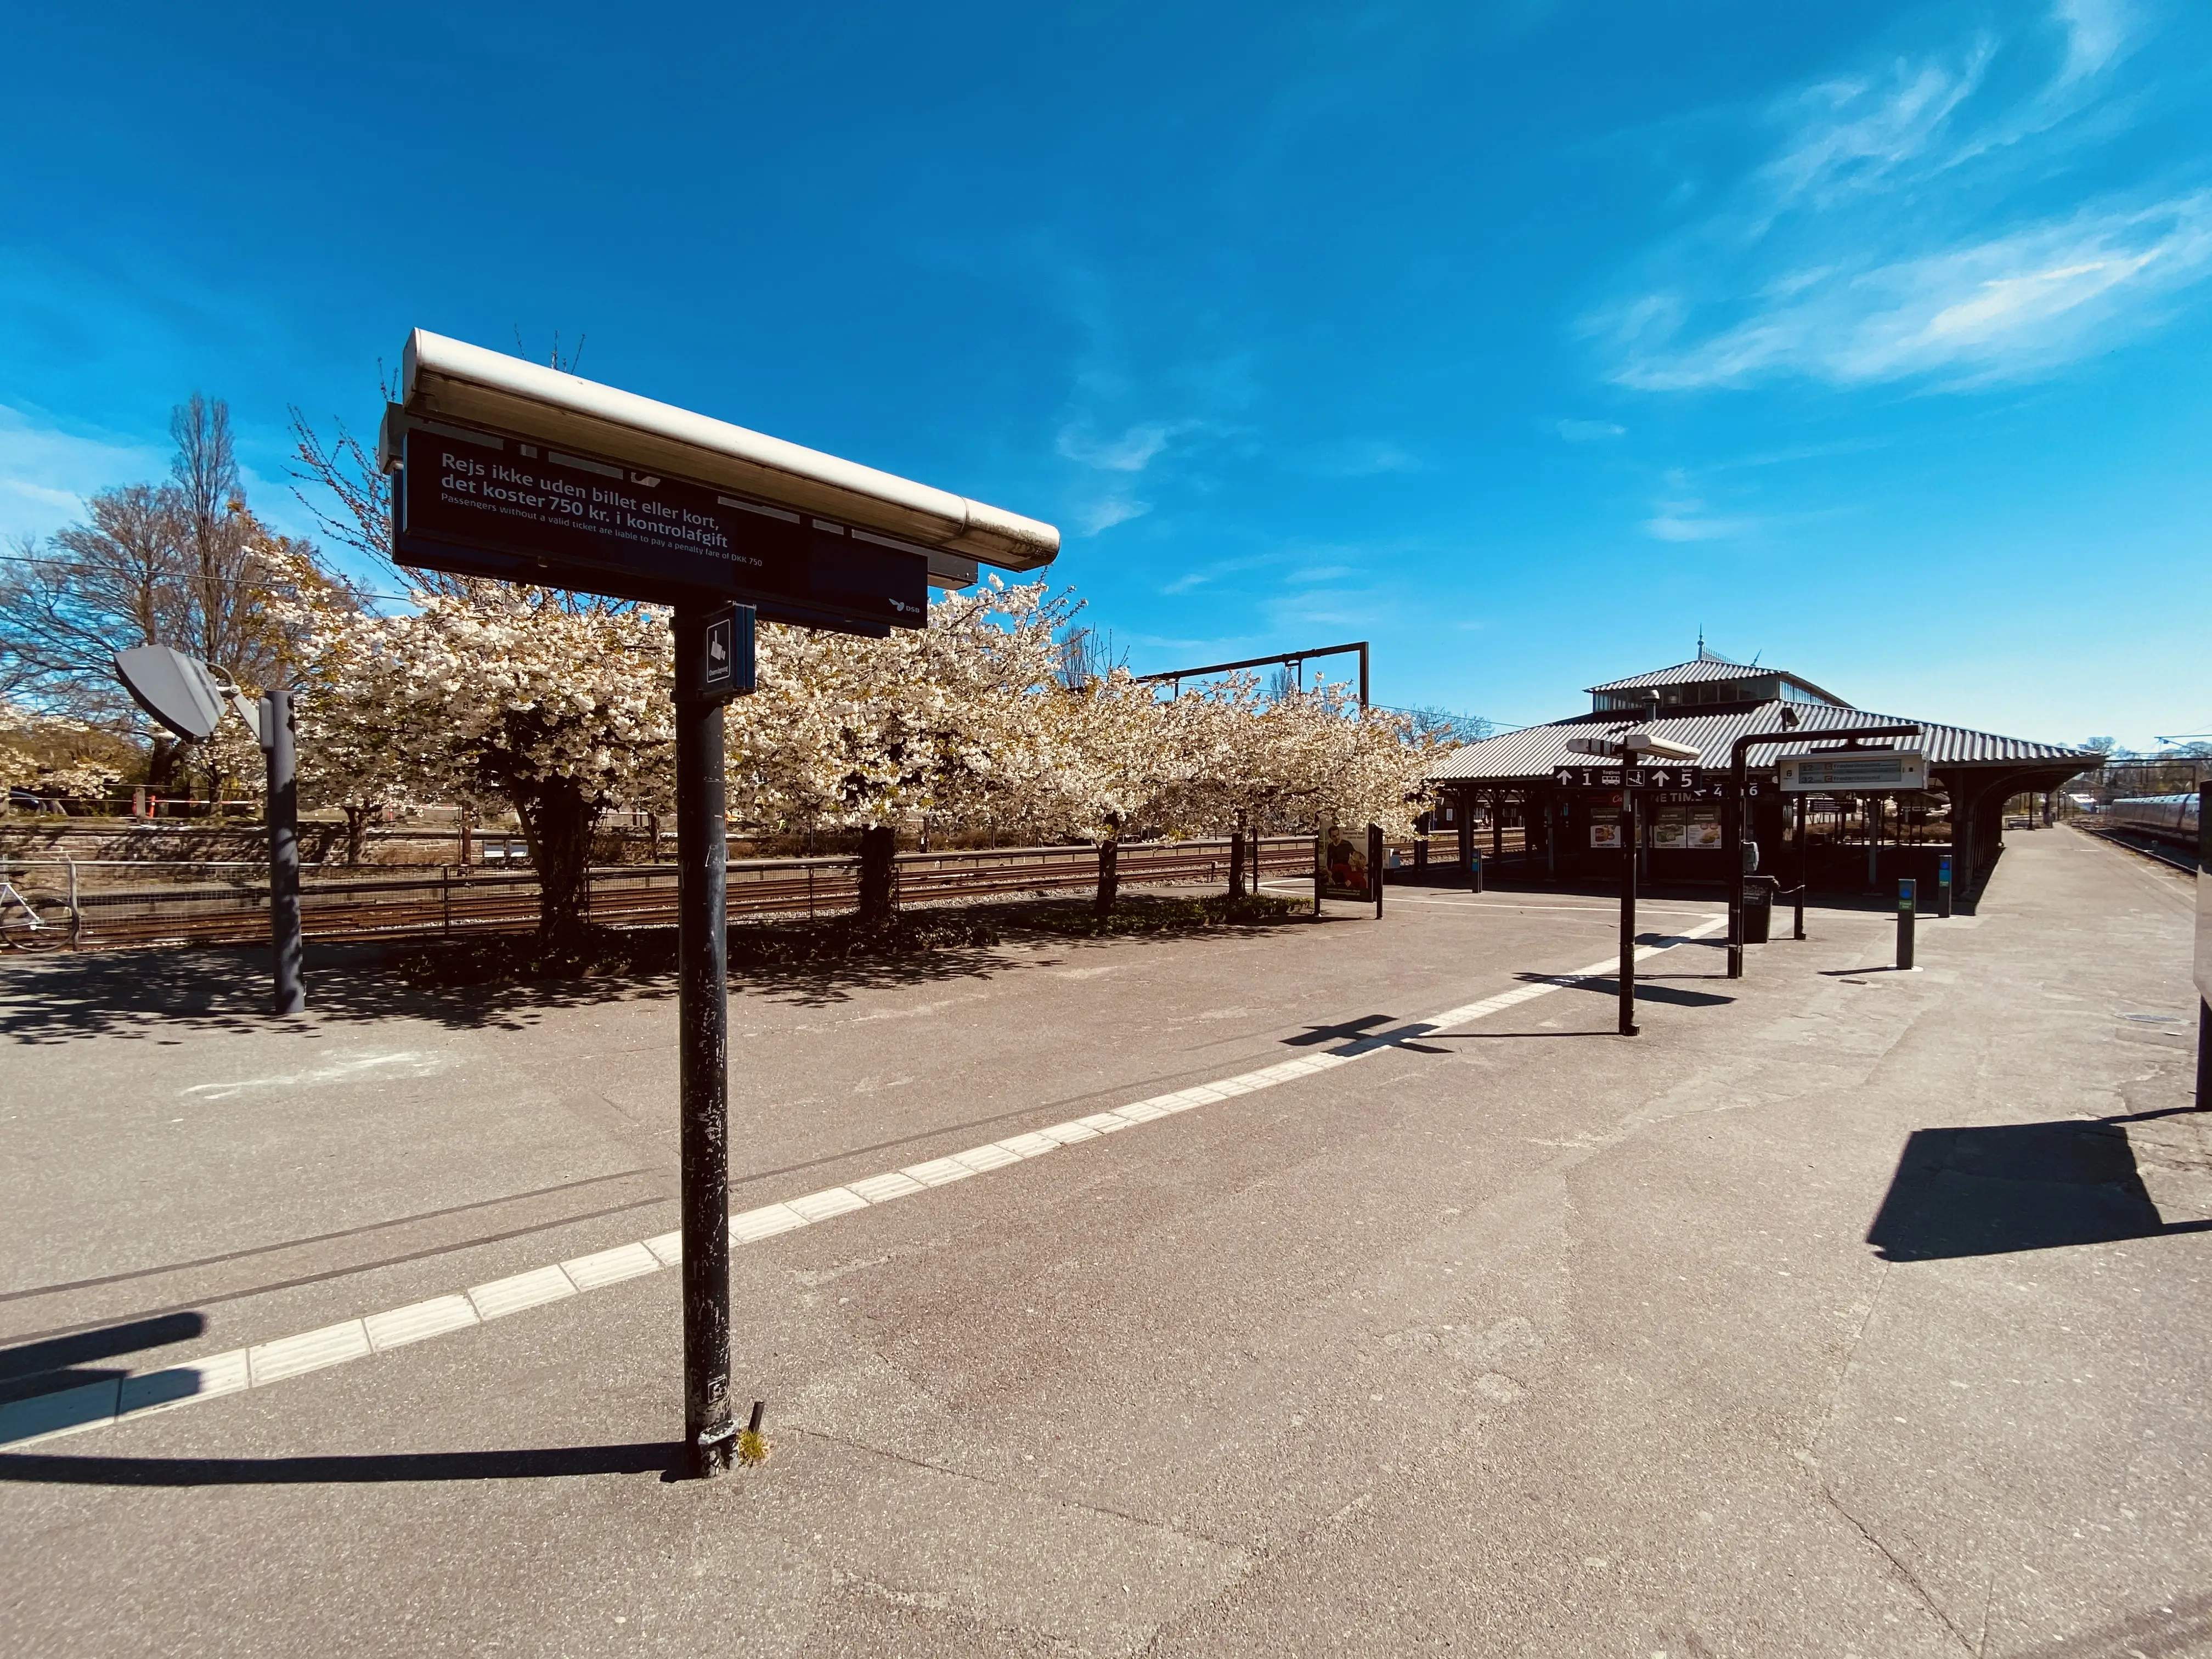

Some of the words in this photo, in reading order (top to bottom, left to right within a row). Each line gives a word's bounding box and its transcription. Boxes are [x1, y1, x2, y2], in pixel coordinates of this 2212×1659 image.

[442, 453, 485, 476] Rejs
[493, 464, 533, 486] ikke
[540, 479, 586, 498] uden
[593, 487, 637, 510] billet
[642, 501, 679, 519] eller
[683, 509, 719, 531] kort,
[442, 473, 476, 493] det
[483, 481, 545, 507] koster
[549, 496, 583, 515] 750
[589, 505, 610, 522] kr.
[617, 511, 620, 524] i
[627, 513, 728, 548] kontrolafgift
[442, 493, 496, 511] Passengers
[499, 506, 537, 520] without
[549, 517, 569, 526] valid
[572, 522, 596, 532] ticket
[599, 527, 613, 535] are
[615, 529, 637, 540] liable
[651, 538, 665, 548] pay
[675, 543, 703, 555] penalty
[706, 548, 720, 558] fare
[731, 554, 747, 563] DKK
[749, 557, 763, 567] 750
[1582, 772, 1592, 786] 1
[1681, 774, 1692, 787] 5
[1713, 787, 1722, 797] 4
[1749, 786, 1758, 796] 6
